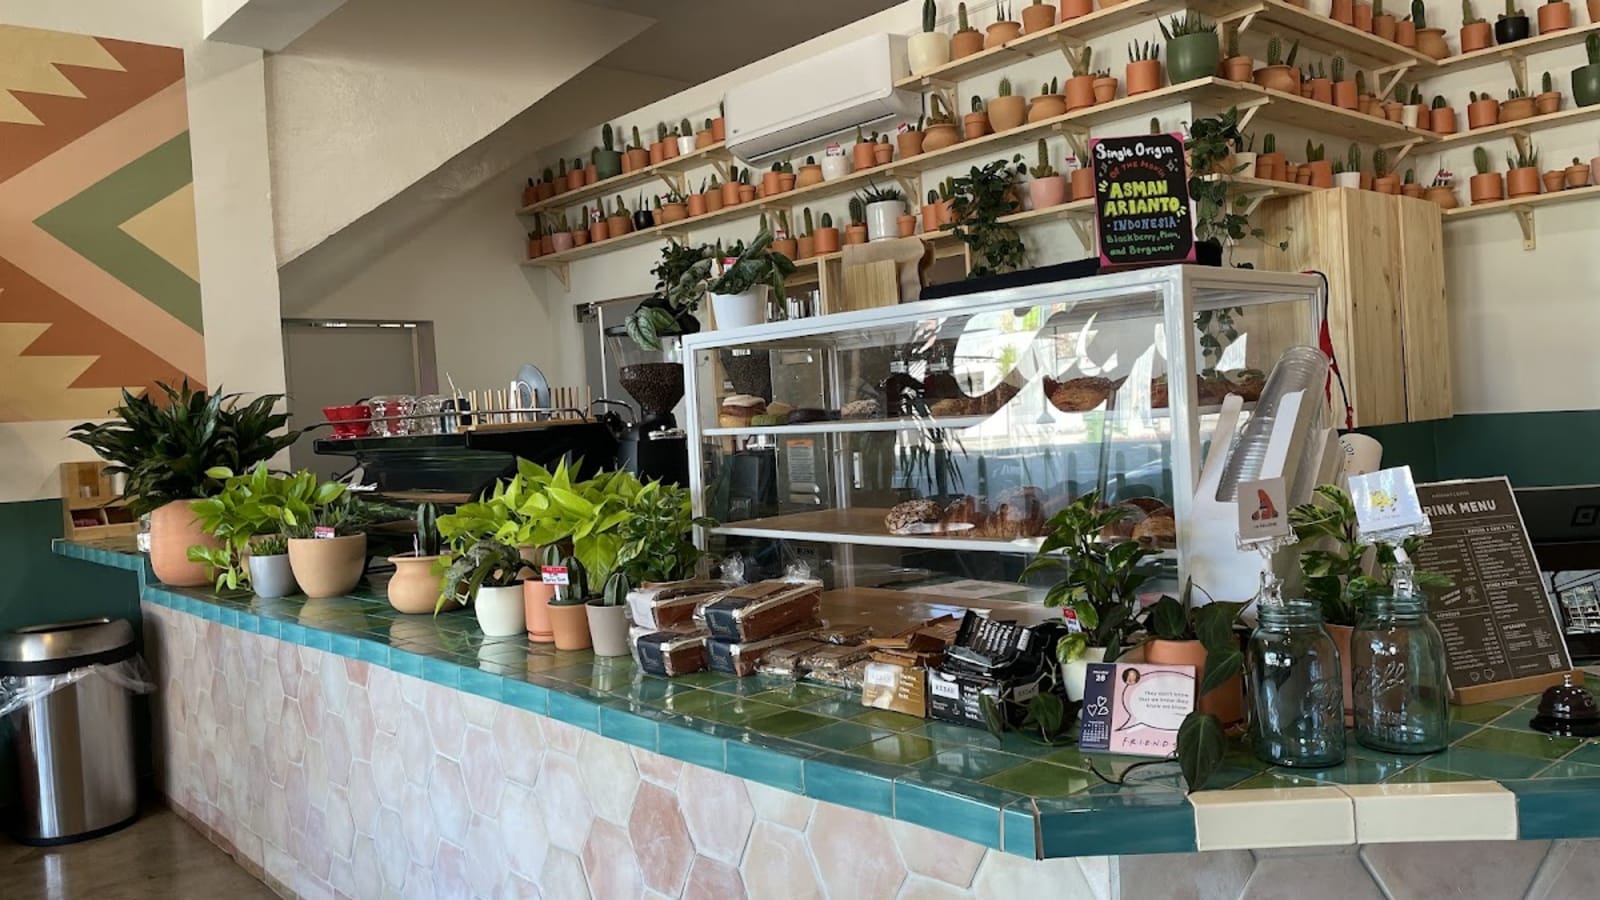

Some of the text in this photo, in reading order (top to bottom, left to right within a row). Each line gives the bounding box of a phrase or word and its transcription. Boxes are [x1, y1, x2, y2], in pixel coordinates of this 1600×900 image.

[1095, 142, 1174, 161] Single Origin
[1109, 180, 1168, 199] ASMAN
[1103, 197, 1180, 217] ARIANTO
[1113, 216, 1177, 231] INDONESIA
[1423, 500, 1497, 517] RINK MENU
